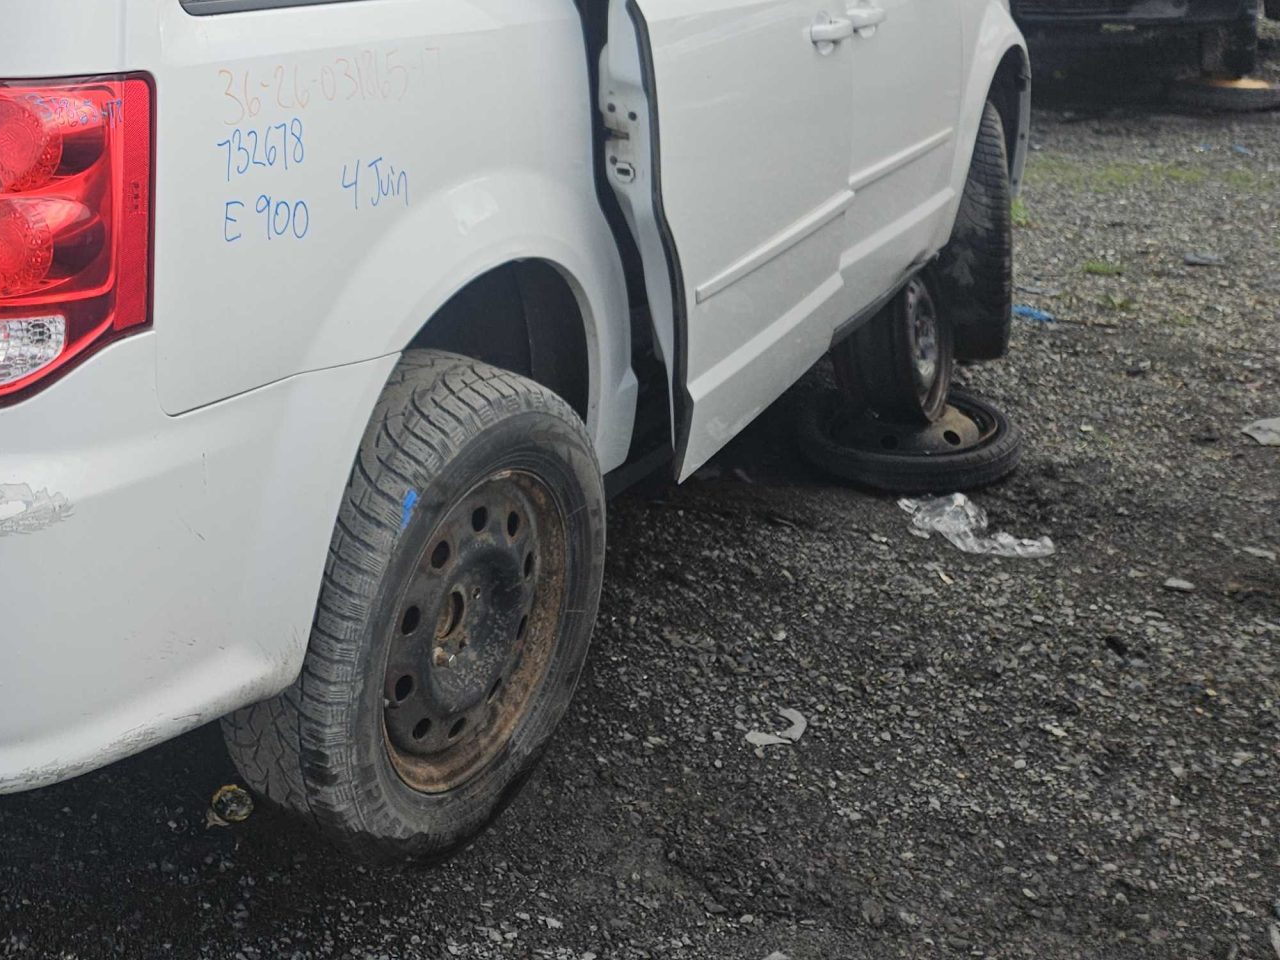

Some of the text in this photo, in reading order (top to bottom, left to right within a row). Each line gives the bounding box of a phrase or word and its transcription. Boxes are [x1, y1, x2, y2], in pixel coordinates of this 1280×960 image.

[217, 117, 305, 182] 732678
[341, 157, 409, 210] 4 Juin
[224, 194, 310, 242] E 900
